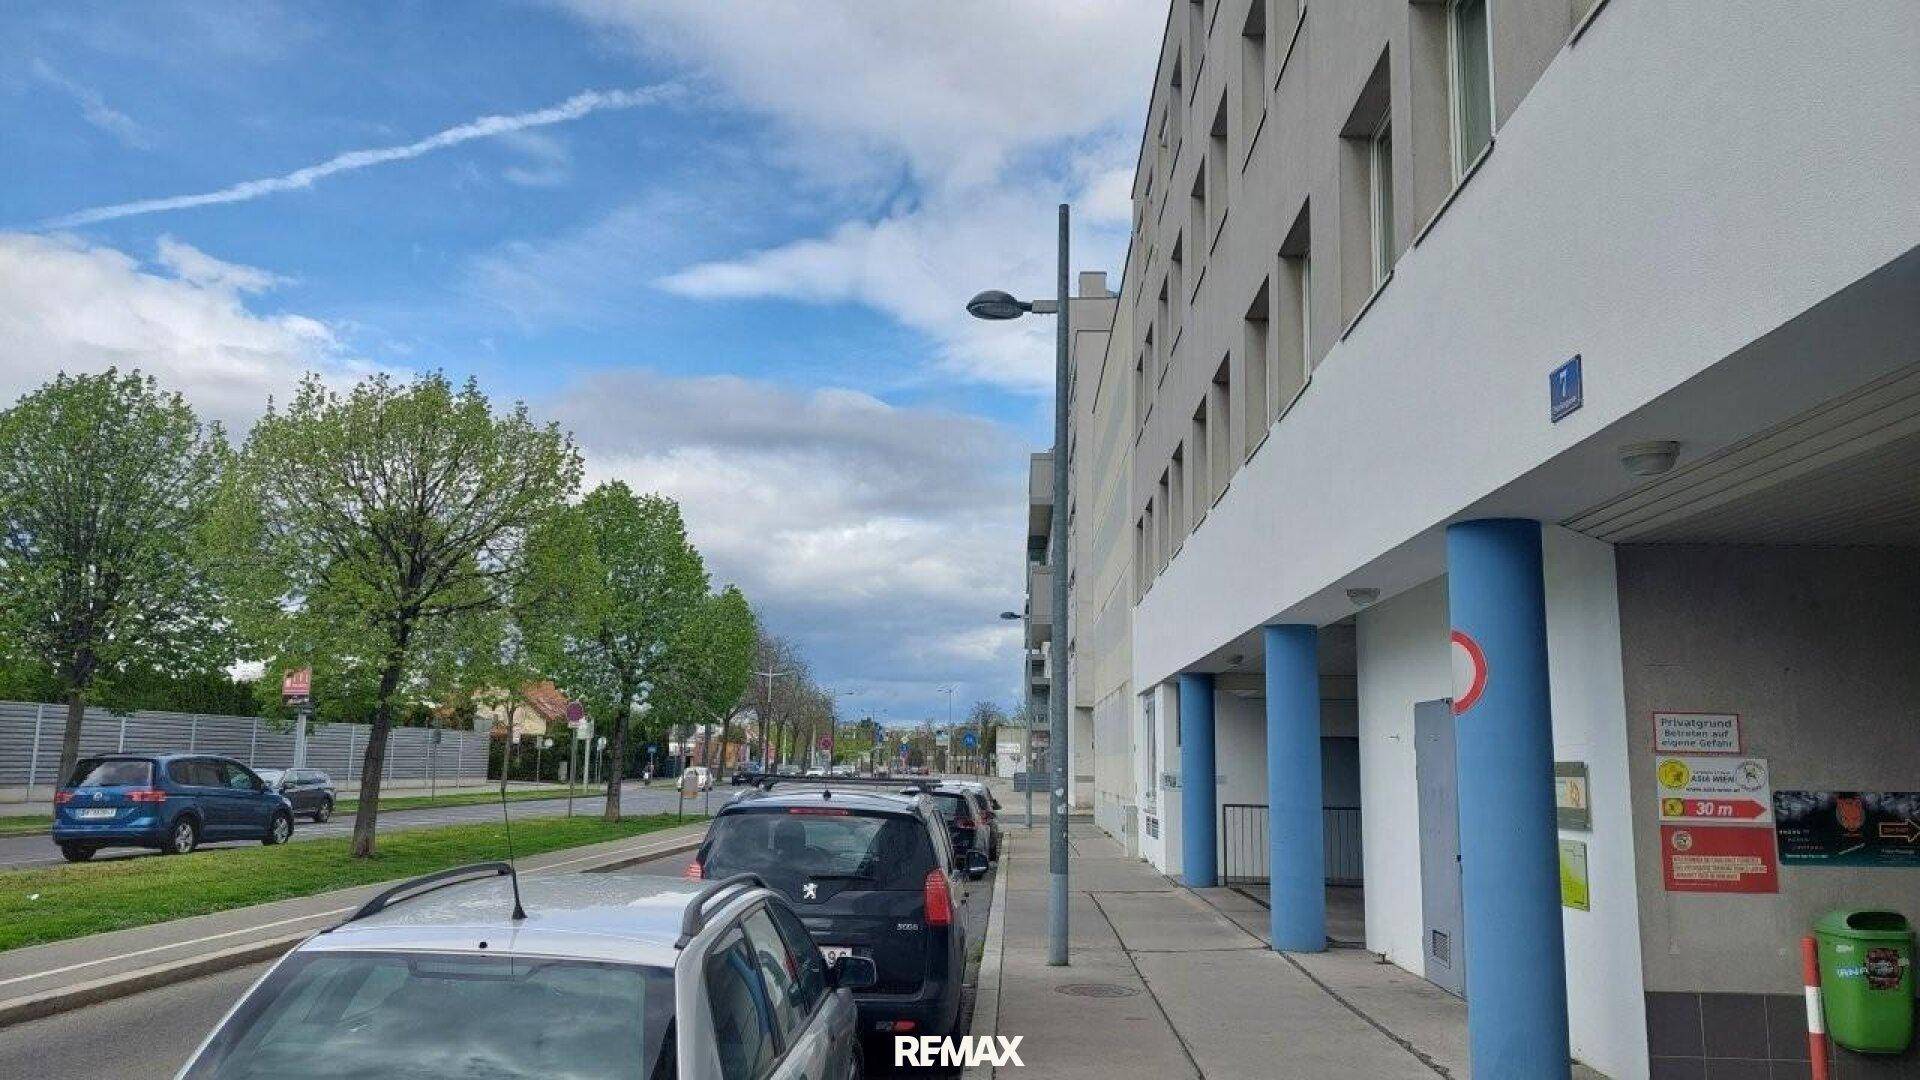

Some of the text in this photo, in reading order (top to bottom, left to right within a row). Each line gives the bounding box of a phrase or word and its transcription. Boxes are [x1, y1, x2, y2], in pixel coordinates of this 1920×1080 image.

[1559, 368, 1568, 398] 7
[1661, 718, 1732, 729] Privatgrund
[1664, 729, 1729, 738] Betreten auf
[1661, 739, 1732, 748] eigene Gefahr
[1712, 775, 1735, 783] WIEN
[1696, 802, 1733, 816] 30 m
